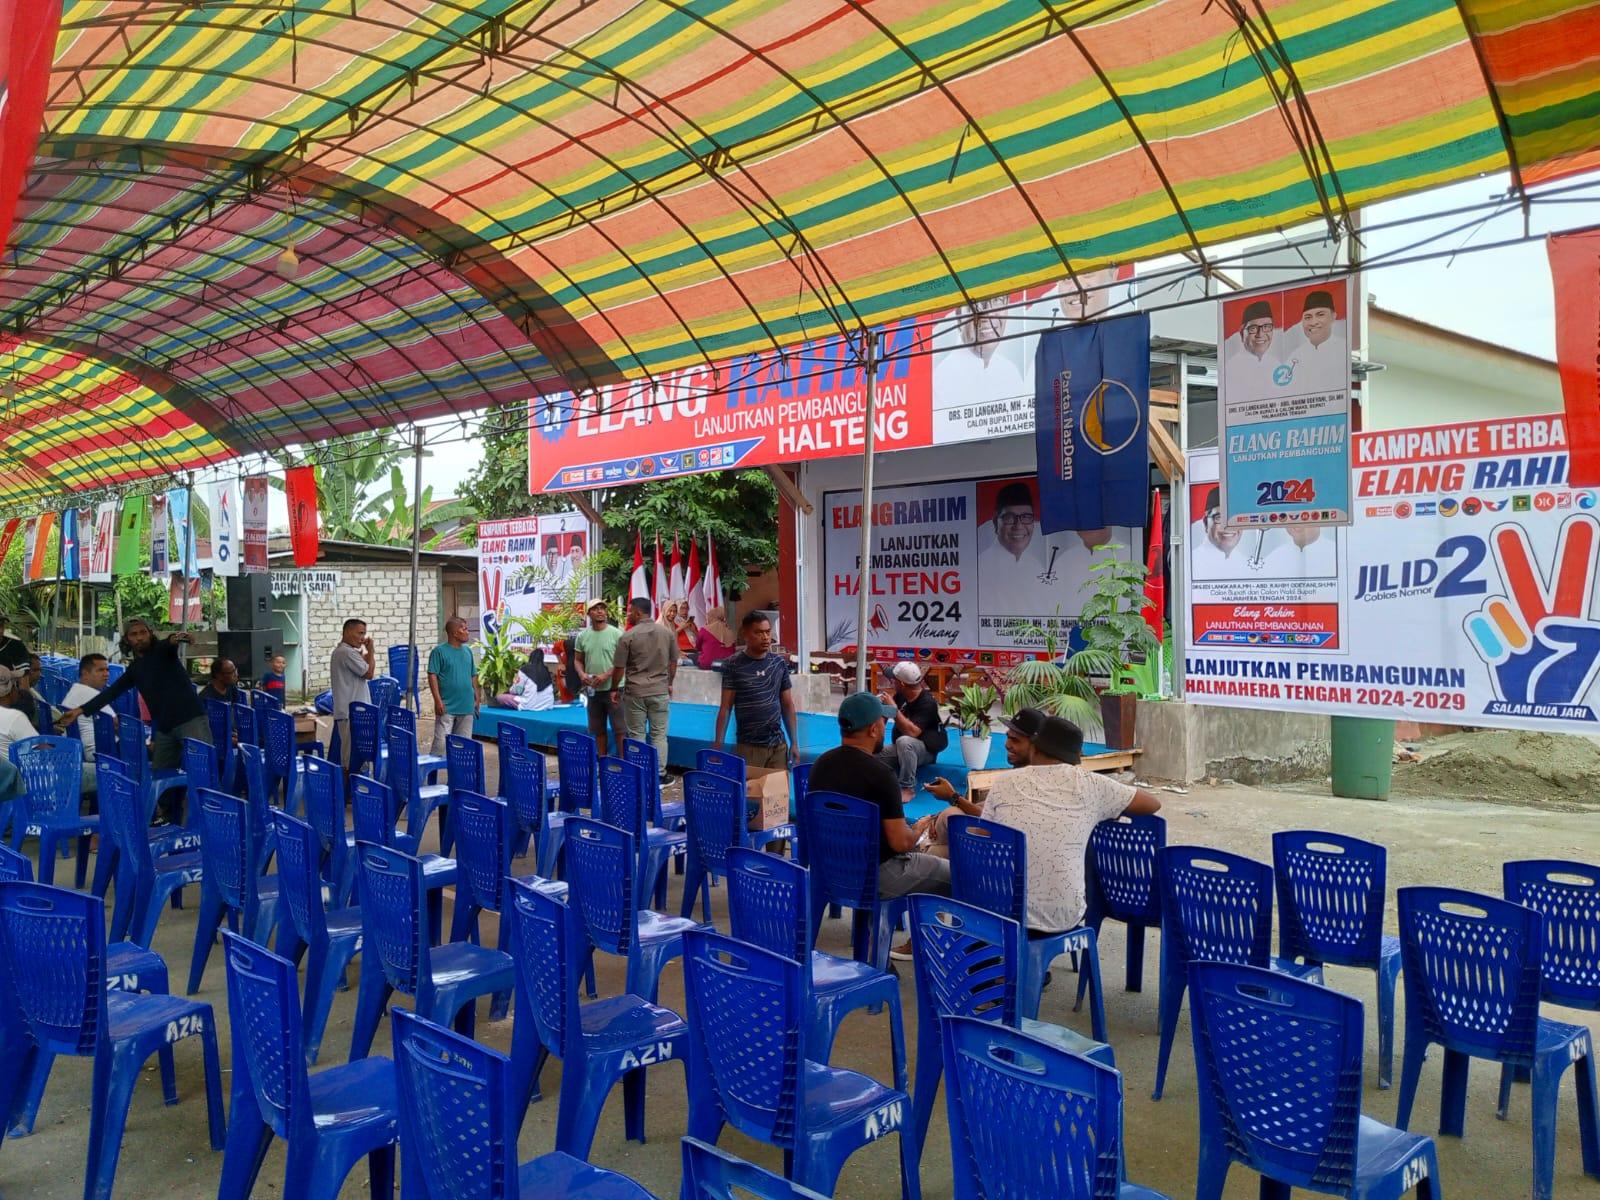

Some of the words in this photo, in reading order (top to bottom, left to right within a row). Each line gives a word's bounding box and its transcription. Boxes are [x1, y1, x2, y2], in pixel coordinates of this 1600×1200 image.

[577, 364, 709, 437] ELANG
[726, 316, 916, 409] RAHIM
[1061, 370, 1072, 414] Partai
[694, 405, 775, 438] LANJUTKAN
[778, 383, 907, 426] PEMBANGUNAN
[1010, 399, 1021, 411] MH
[967, 419, 988, 429] CALON
[989, 414, 1013, 426] BUPATI
[1014, 412, 1028, 421] DAN
[988, 421, 1036, 435] HALMAHER
[778, 410, 908, 455] HALTENG
[1229, 431, 1281, 454] ELANG
[1286, 424, 1345, 448] RAHIM
[1359, 426, 1480, 463] KAMPANYE
[1486, 419, 1566, 451] TERBA
[1063, 417, 1075, 480] NasDem
[1233, 451, 1277, 463] LANJUTKAN
[1279, 446, 1342, 459] PEMBANGUNAN
[1357, 463, 1466, 498] ELANG
[1472, 455, 1569, 490] RAHI
[1257, 477, 1316, 506] 2024
[560, 519, 566, 531] 2
[482, 539, 506, 553] ELANG
[508, 537, 536, 552] RAHIM
[881, 533, 960, 552] LANJUTKAN
[855, 552, 960, 570] PMBANGUNAN
[1355, 558, 1438, 600] JILID
[1434, 535, 1488, 598] 2
[834, 570, 961, 596] HALTENG
[1364, 590, 1397, 602] Coblos
[1399, 586, 1433, 598] Nomor
[897, 600, 962, 622] 2024
[1233, 606, 1261, 620] Elang
[1264, 606, 1296, 618] Rahim
[909, 622, 960, 645] Menang
[1206, 621, 1253, 630] LANJUTKAN
[1254, 621, 1324, 630] PEMBANGUNAN
[1185, 658, 1291, 680] LANJUTKAN
[1297, 662, 1465, 689] PEMBANGUNAN
[1185, 679, 1281, 699] HALMAHERA
[1284, 684, 1351, 704] TENGAH
[1356, 688, 1466, 711] 2024-2029
[1492, 702, 1532, 715] SALAM
[1534, 705, 1558, 717] DUA
[1560, 707, 1588, 719] JARI
[175, 834, 202, 850] AZN
[182, 868, 204, 882] AZ
[106, 974, 138, 991] ZN
[166, 1014, 204, 1042] AZN
[619, 1041, 673, 1071] AZN
[1403, 1154, 1429, 1193] AZN
